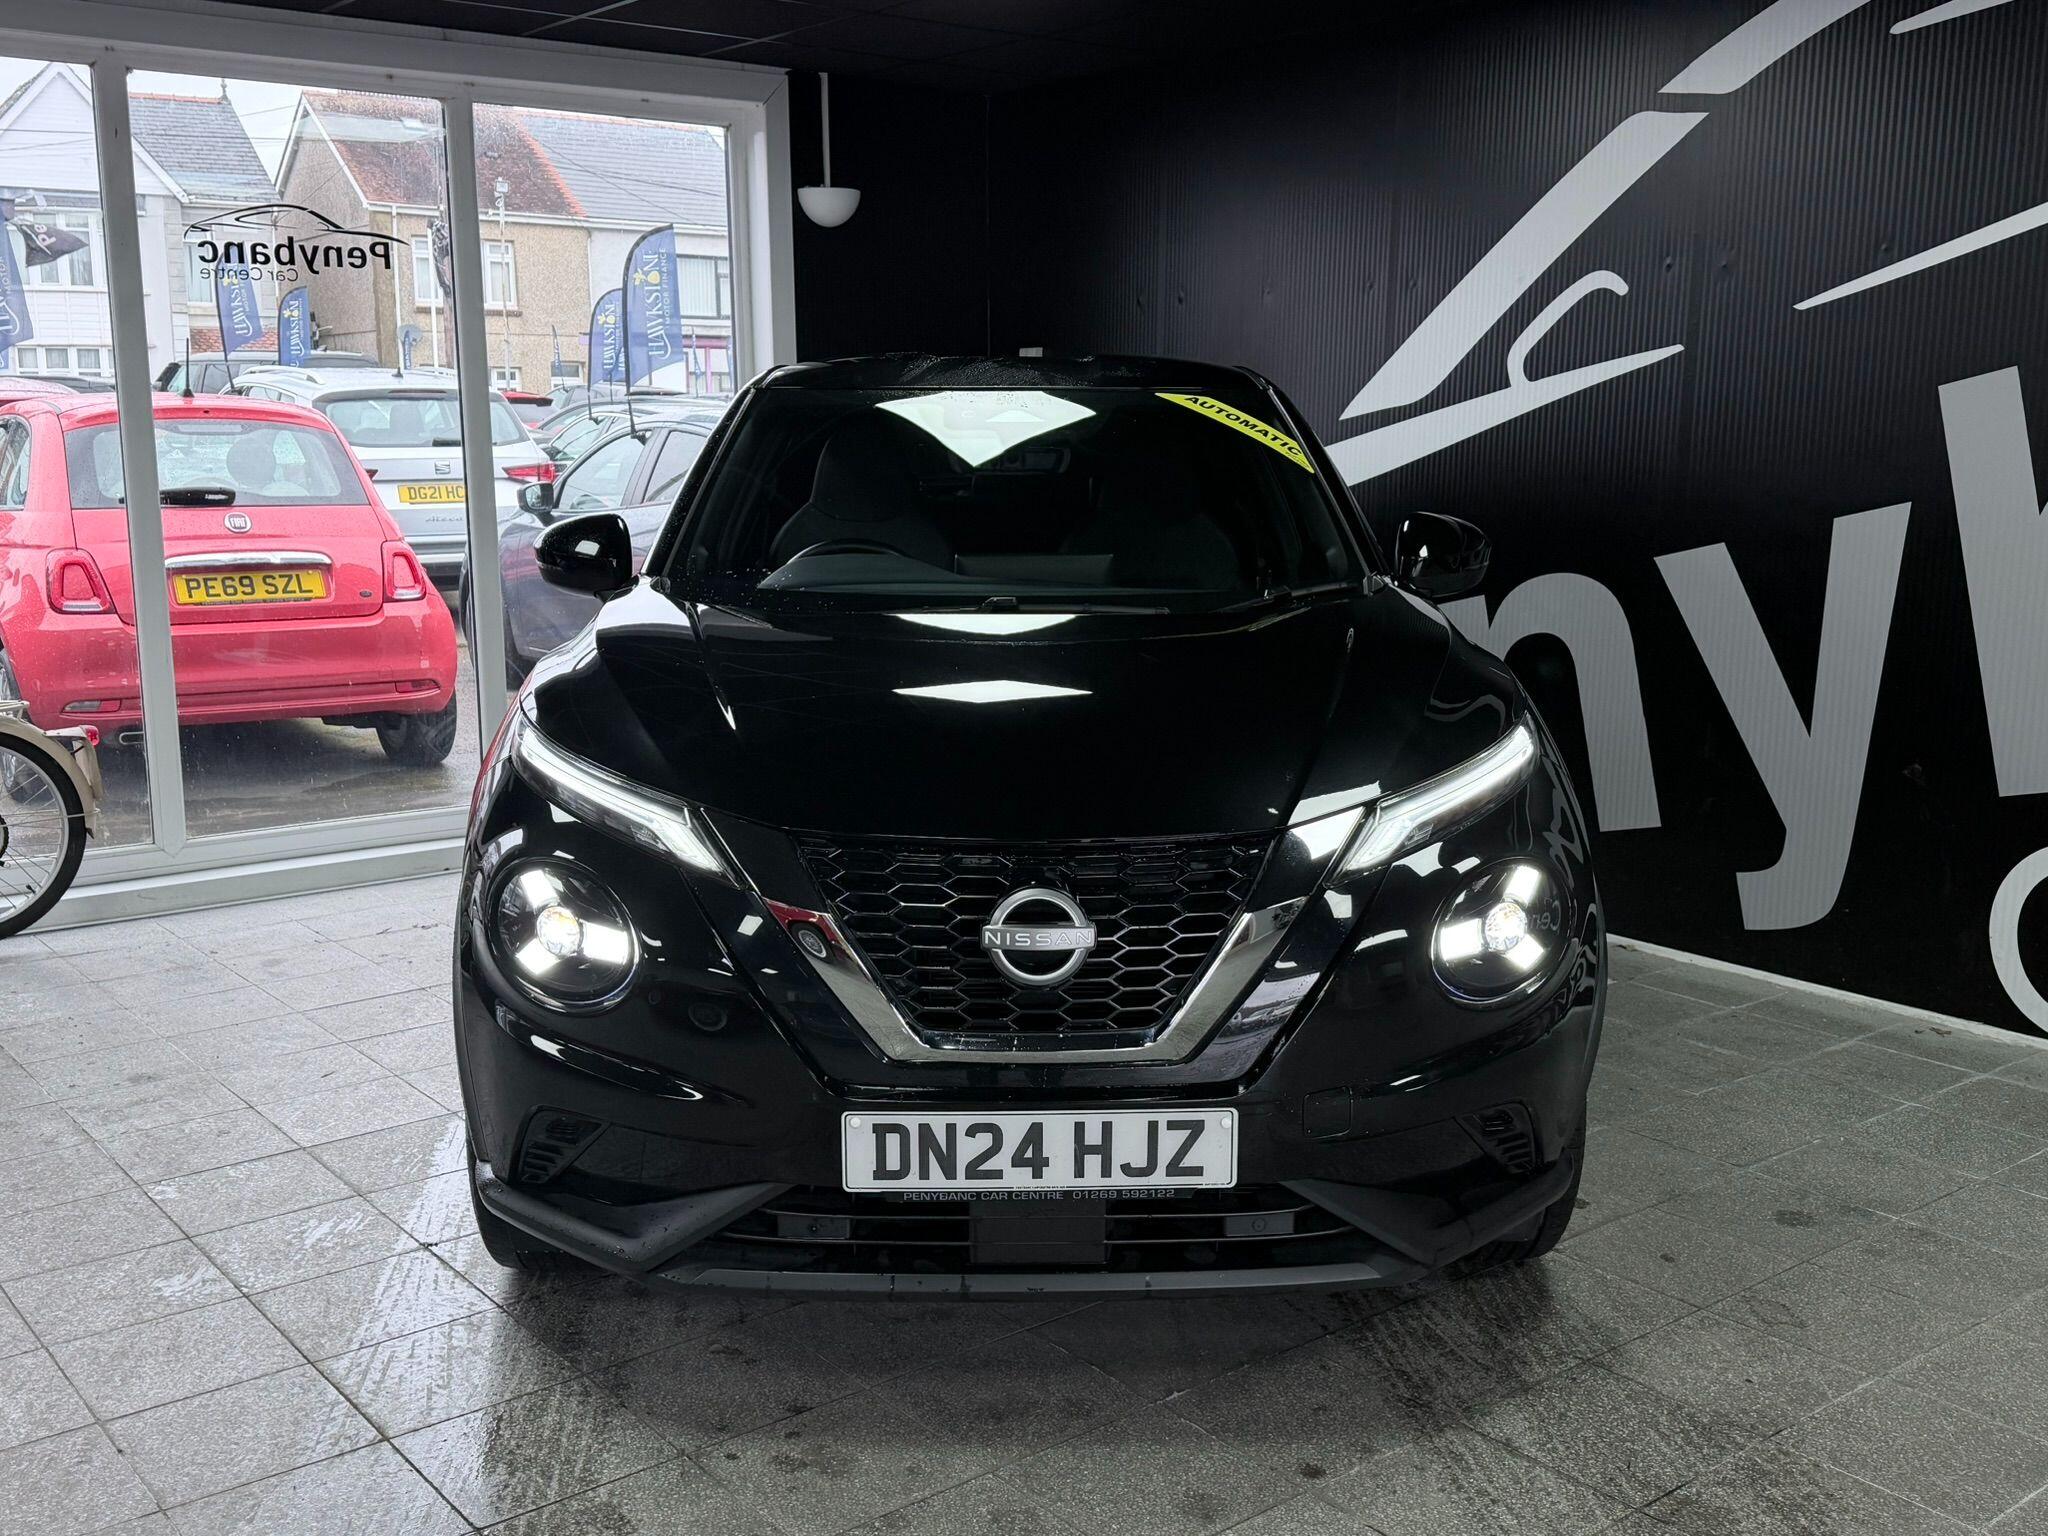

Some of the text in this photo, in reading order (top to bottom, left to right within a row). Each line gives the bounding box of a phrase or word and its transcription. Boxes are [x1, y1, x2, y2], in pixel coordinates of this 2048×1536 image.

[659, 248, 671, 325] MOTOR FINANCE
[1184, 396, 1302, 456] AUTOMATIC
[407, 485, 442, 500] DG21
[184, 573, 314, 599] PE69 SZL
[984, 931, 1093, 946] NISSAN
[872, 1119, 1205, 1181] DN24 HJZ
[903, 1189, 1175, 1201] PENYBANC CAR CENTRE 01269 592122
